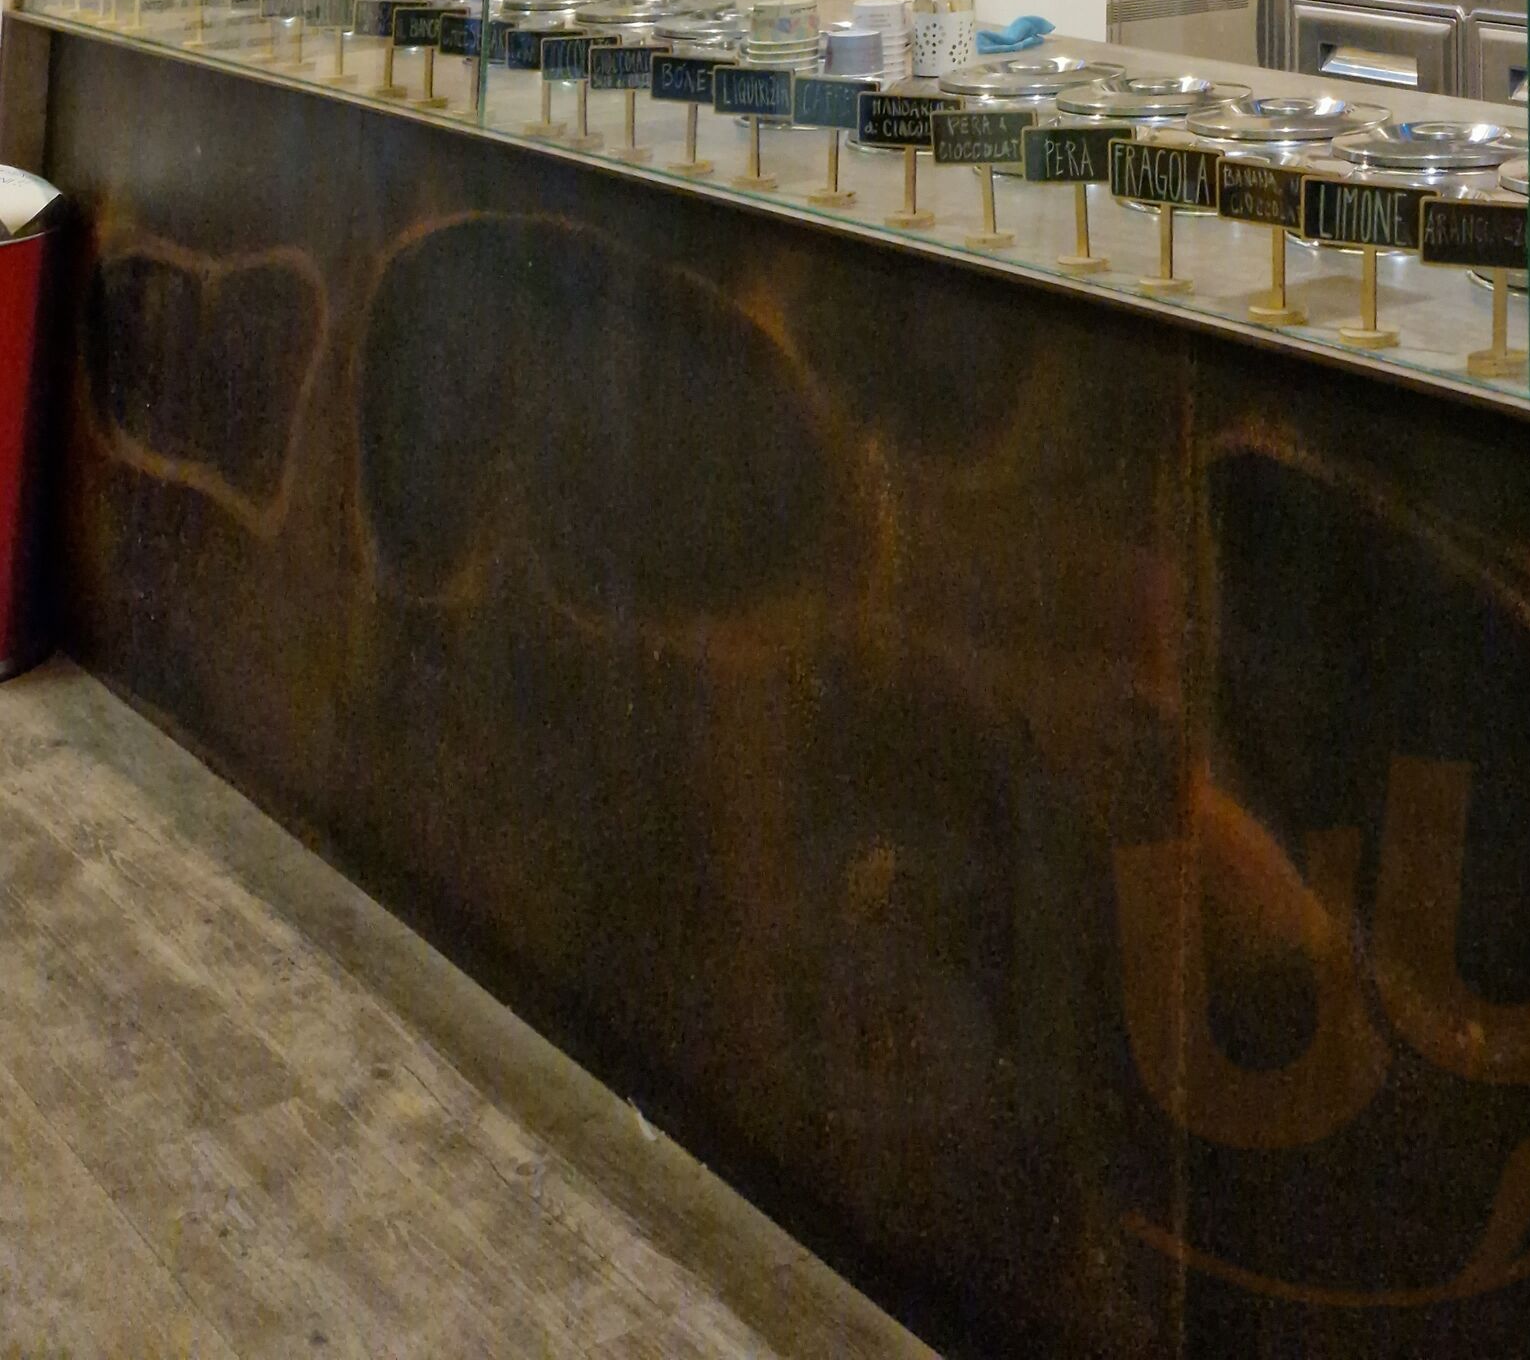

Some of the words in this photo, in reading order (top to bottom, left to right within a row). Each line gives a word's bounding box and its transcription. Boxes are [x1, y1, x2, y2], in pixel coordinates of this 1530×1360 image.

[939, 139, 1021, 160] CIOCCOLAT
[1045, 138, 1094, 178] PERA
[1113, 142, 1210, 204] FRAGOLA
[1318, 184, 1408, 245] LIMONE
